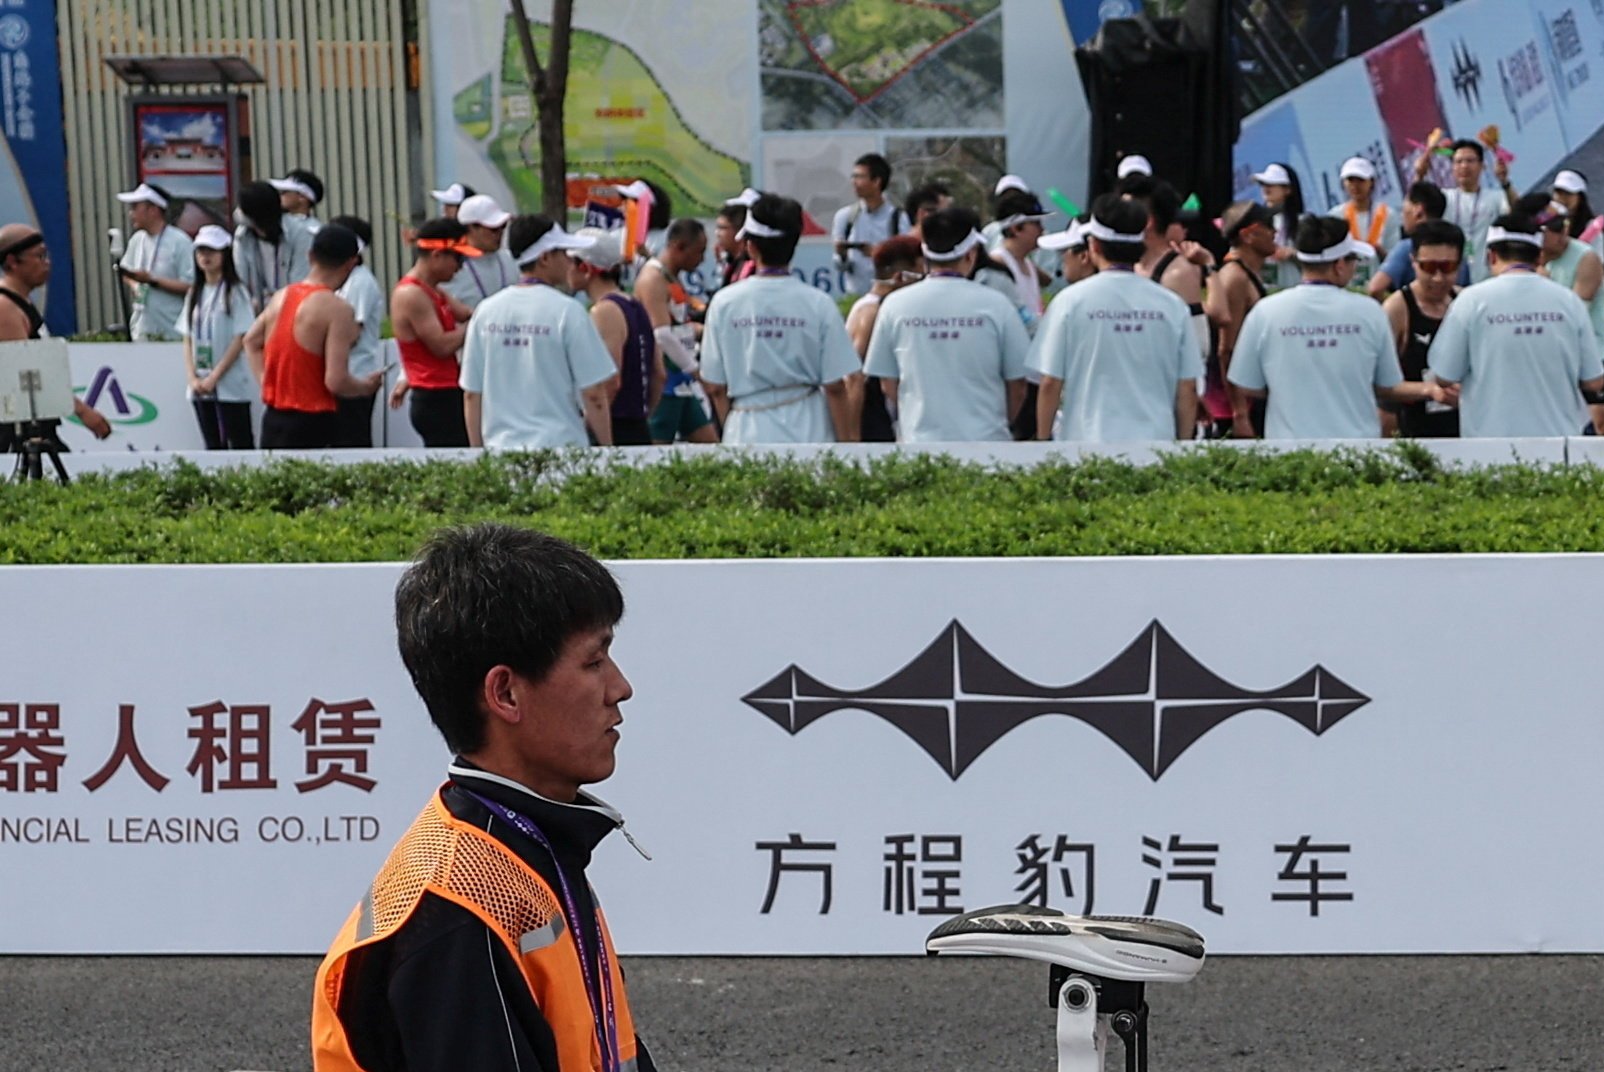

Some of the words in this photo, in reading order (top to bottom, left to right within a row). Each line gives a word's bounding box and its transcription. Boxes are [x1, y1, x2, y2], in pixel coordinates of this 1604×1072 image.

[484, 323, 551, 336] OLUNTEER
[0, 698, 381, 794] 器人租赁
[1, 817, 90, 843] NCIAL
[109, 817, 239, 843] LEASING
[755, 833, 1354, 918] 方程豹汽车
